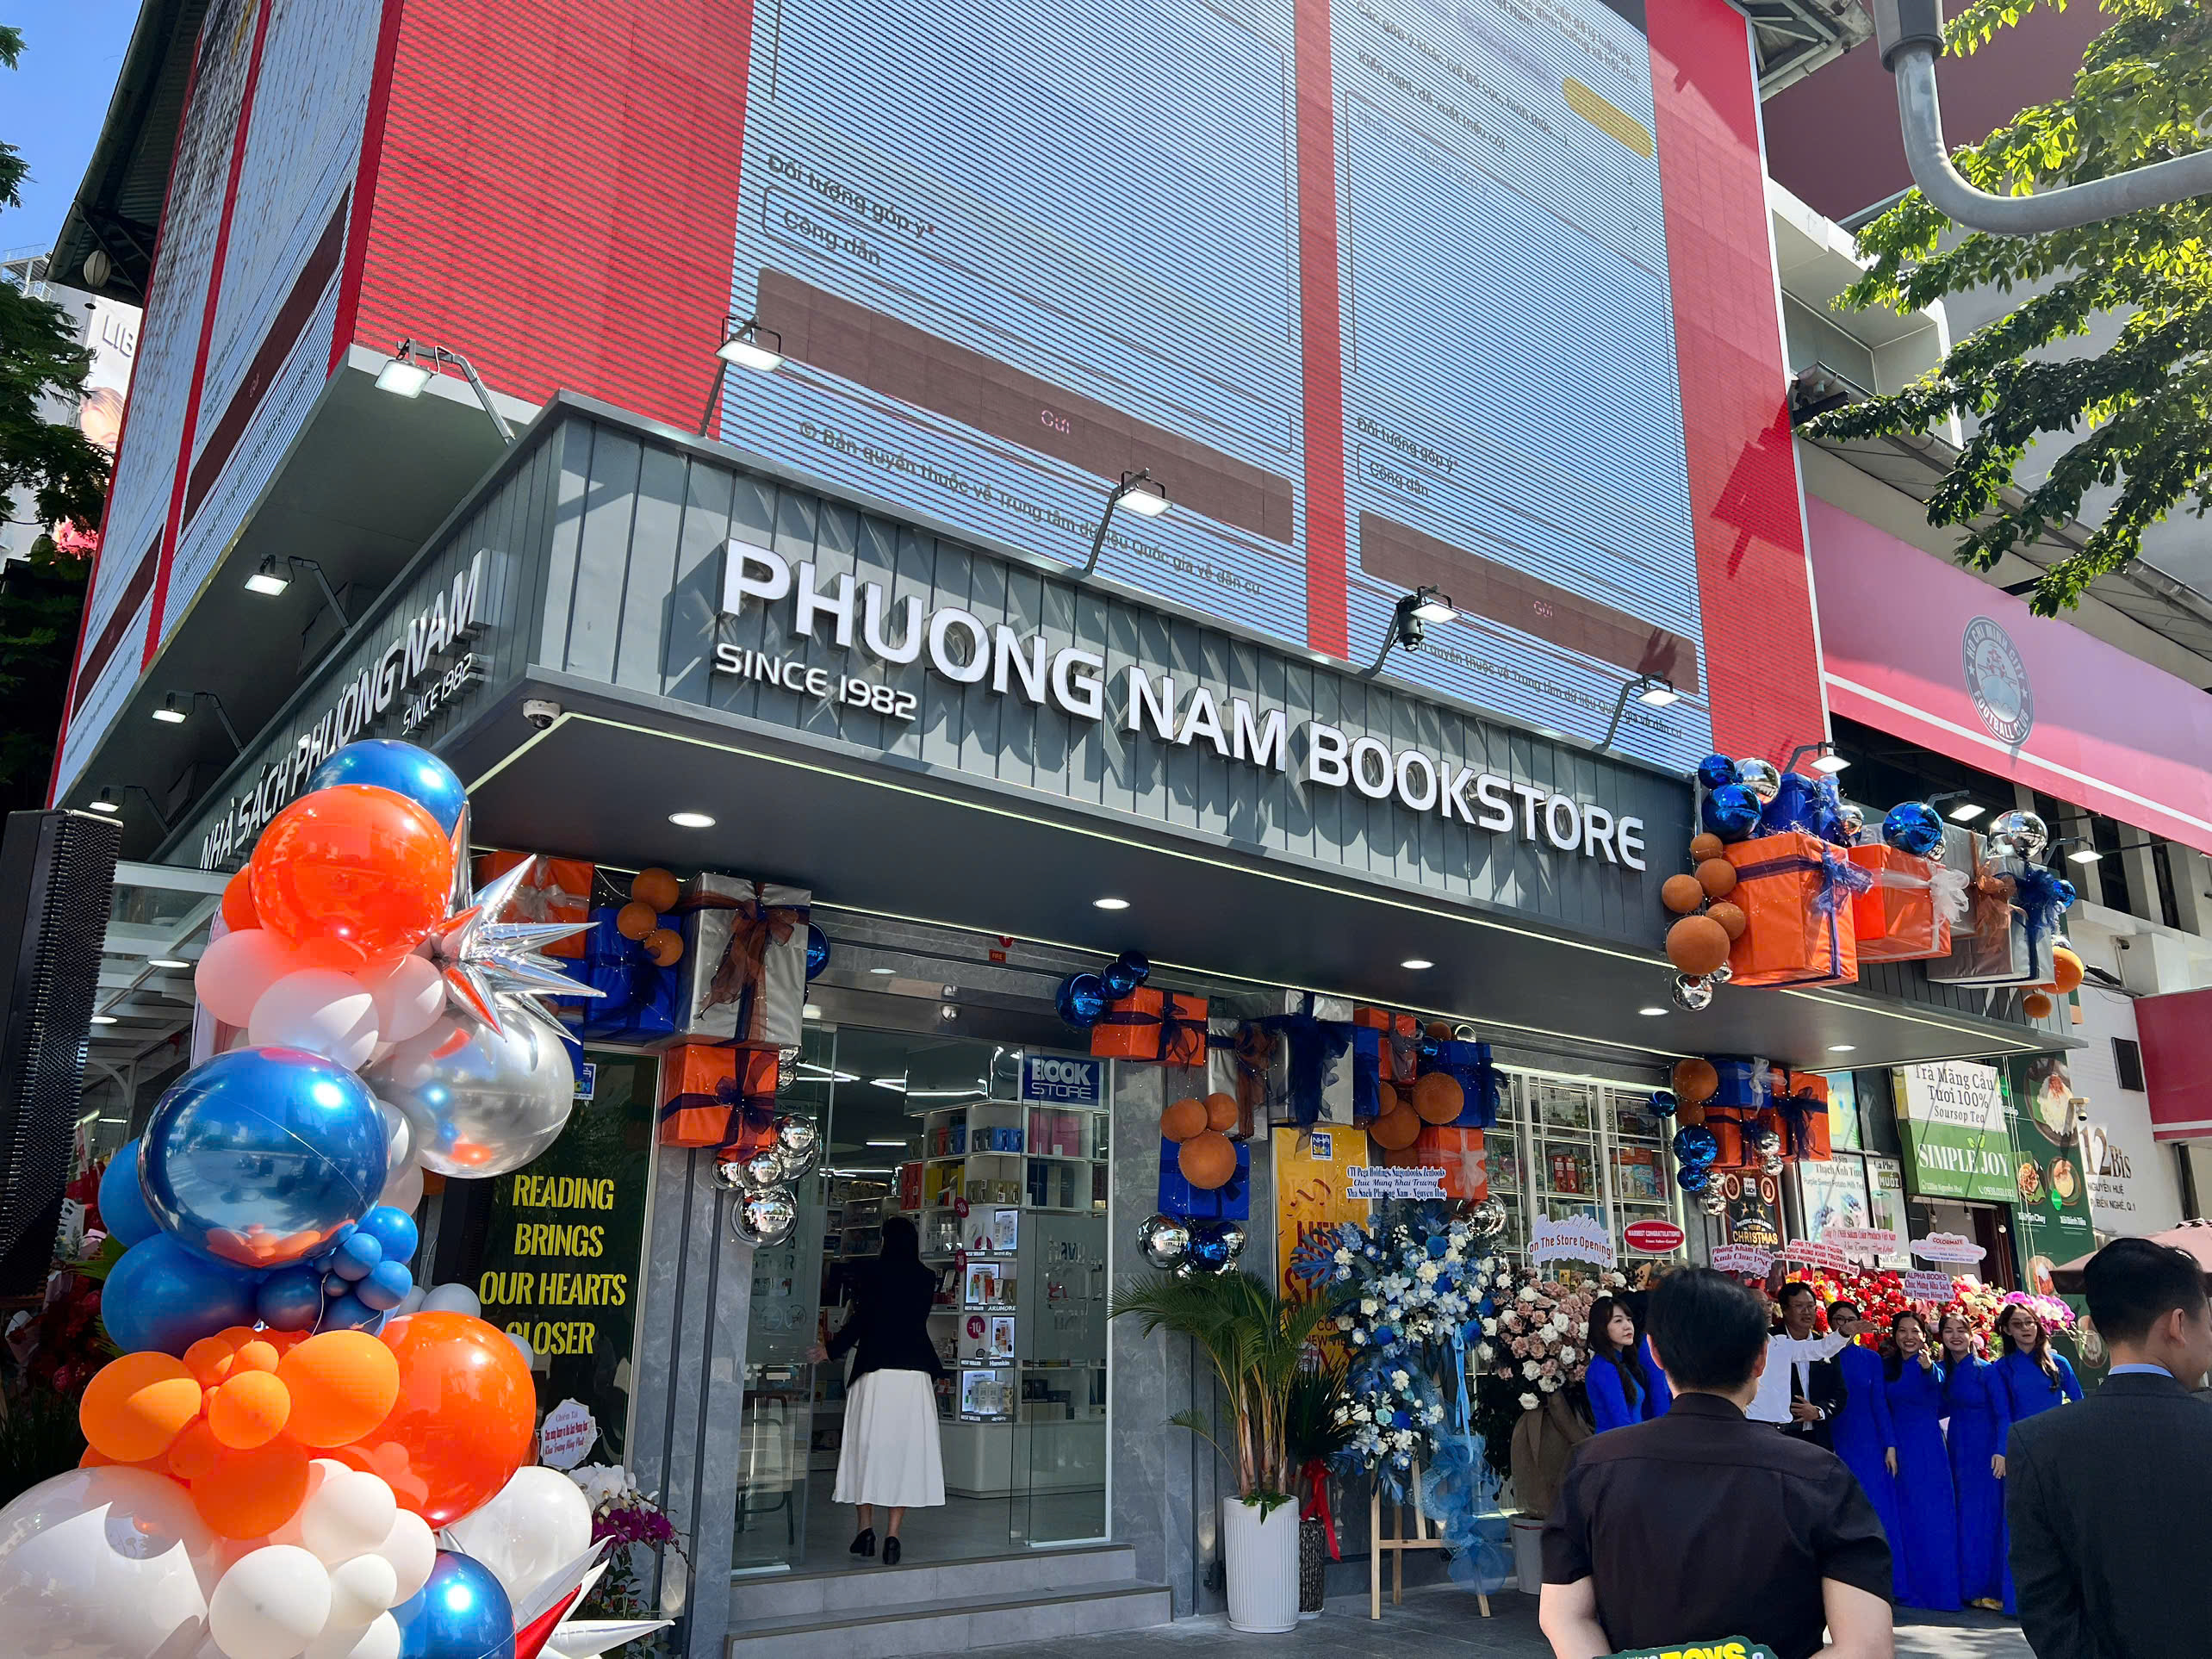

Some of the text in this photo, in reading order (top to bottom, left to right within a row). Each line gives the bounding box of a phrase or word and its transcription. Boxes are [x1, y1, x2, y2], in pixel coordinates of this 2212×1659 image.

[783, 209, 839, 252] Công
[997, 488, 1046, 524] Trung
[401, 549, 482, 691] NAM
[1966, 624, 2025, 680] HO CHI MINH CITY
[401, 652, 473, 736] SINCE 1982
[715, 643, 918, 722] SINCE 1982
[720, 537, 1646, 873] PHUONG NAM BOOKSTORE
[1973, 690, 2029, 740] FOOTBALL CLUB
[1031, 1058, 1091, 1086] BOOK
[1913, 1064, 1995, 1091] Trà Mãng Cầu
[1031, 1082, 1091, 1100] STORE
[1957, 1090, 1989, 1109] 100%
[1934, 1105, 1968, 1124] Soursop
[1970, 1110, 1985, 1124] Tea
[1917, 1143, 2010, 1177] SIMPLE JOY
[512, 1173, 615, 1210] READING
[513, 1222, 605, 1258] BRINGS
[1529, 1241, 1539, 1253] on
[1540, 1236, 1555, 1249] The
[1556, 1234, 1578, 1246] Store
[1579, 1235, 1613, 1260] Opening!
[1732, 1230, 1779, 1246] CHRISTMAS
[1932, 1237, 1964, 1246] COLORMATE
[478, 1271, 627, 1307] OUR HEARTS
[1906, 1271, 1926, 1280] ALPHA
[968, 1322, 982, 1333] -10
